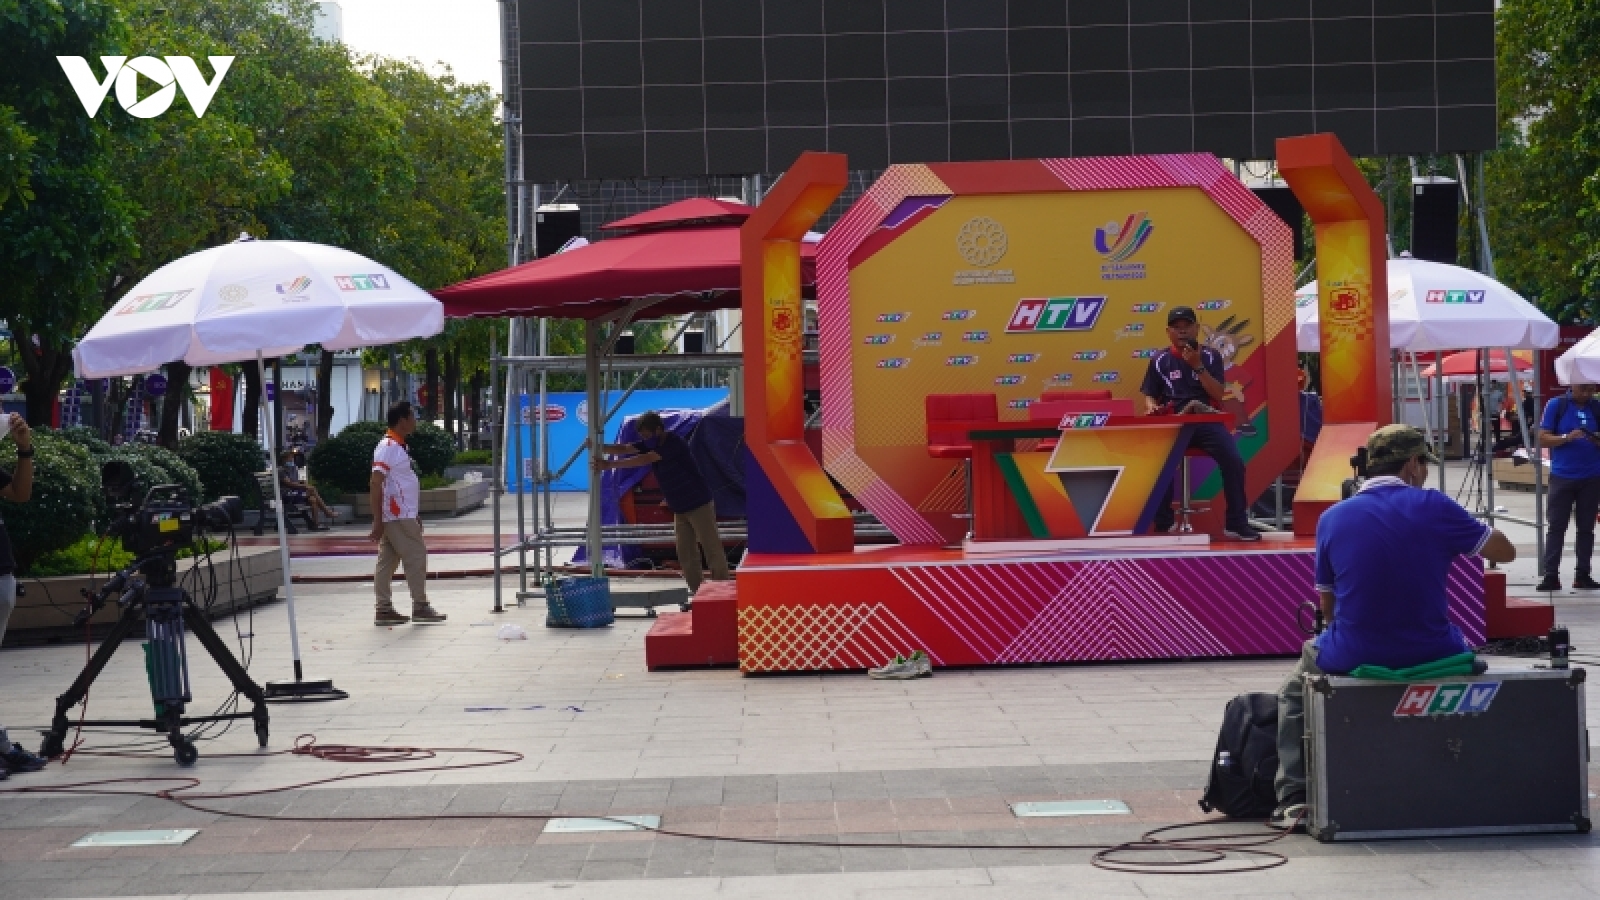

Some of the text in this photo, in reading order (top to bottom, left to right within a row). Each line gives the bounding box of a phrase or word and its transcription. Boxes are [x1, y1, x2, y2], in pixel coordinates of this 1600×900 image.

[335, 274, 390, 291] HTV
[1426, 290, 1485, 304] HTV
[1007, 298, 1104, 333] HTV
[1059, 412, 1111, 430] HTV
[1393, 682, 1501, 716] HTV
